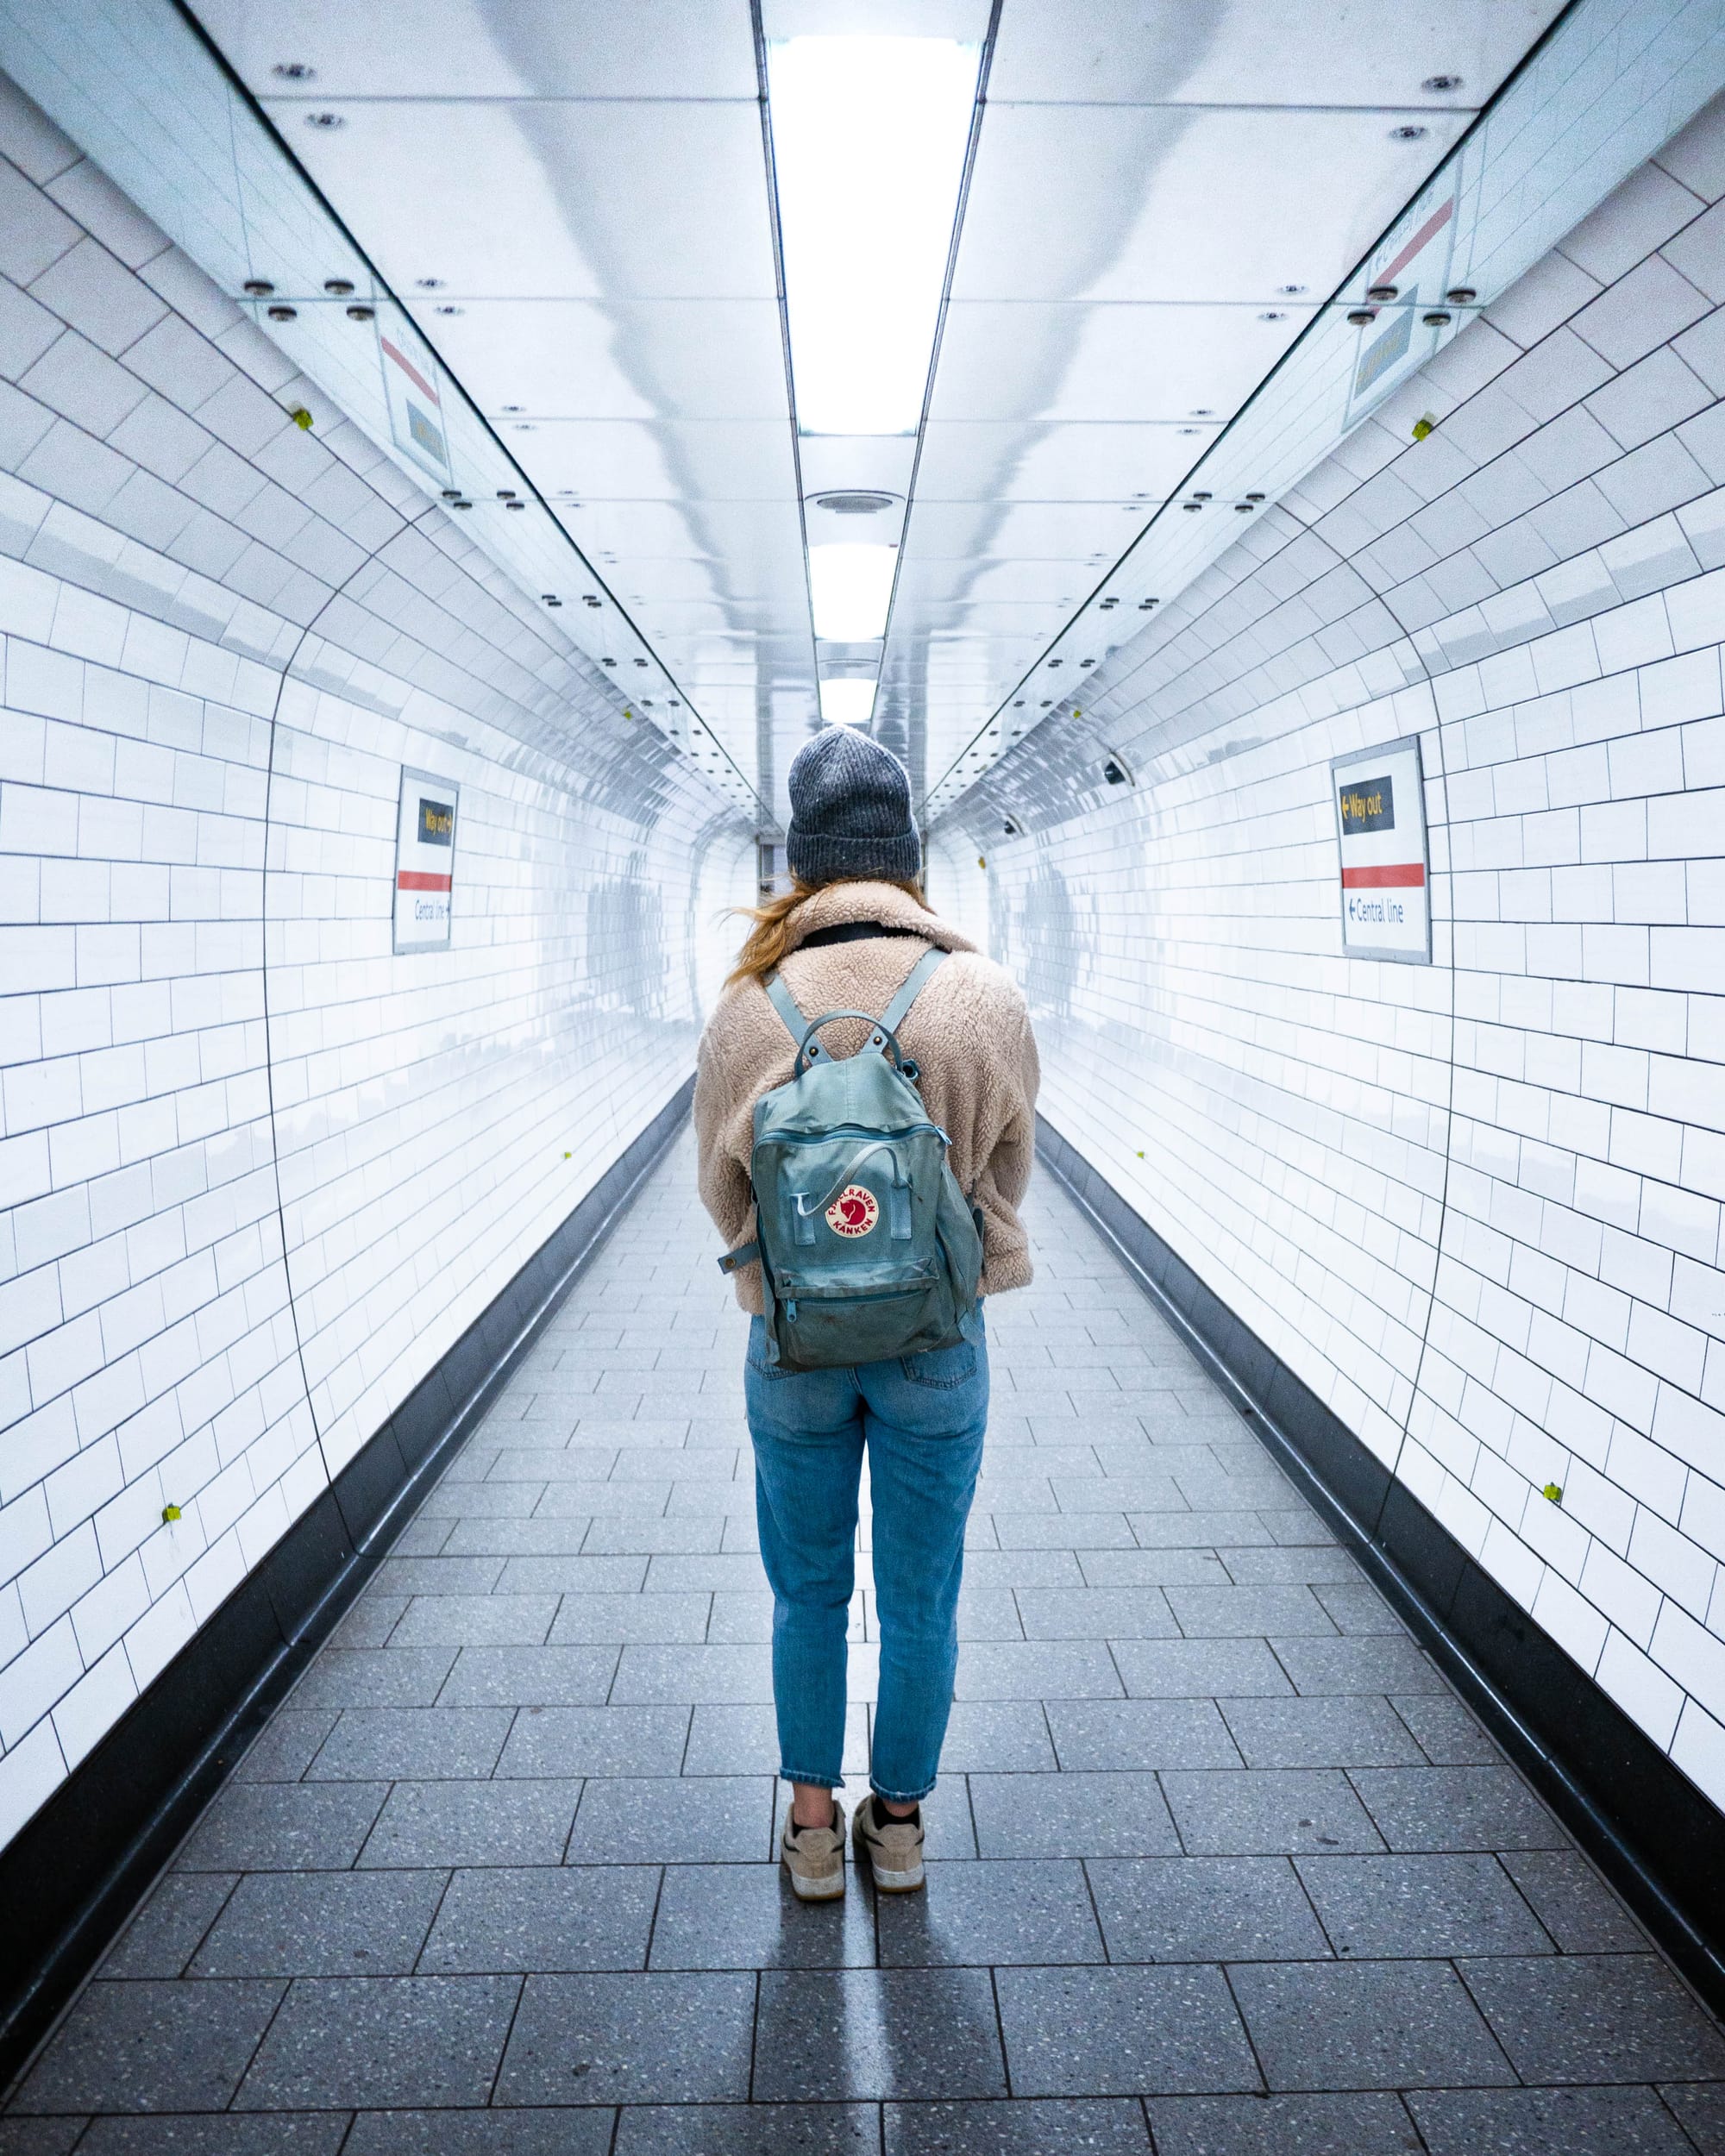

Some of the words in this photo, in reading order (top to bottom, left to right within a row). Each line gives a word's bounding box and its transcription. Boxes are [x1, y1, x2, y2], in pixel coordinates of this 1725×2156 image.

[425, 806, 437, 837] Way
[1349, 793, 1366, 823] Way
[1367, 791, 1383, 816] out
[415, 899, 435, 920] Central
[1357, 897, 1386, 924] Central
[1387, 898, 1404, 924] line
